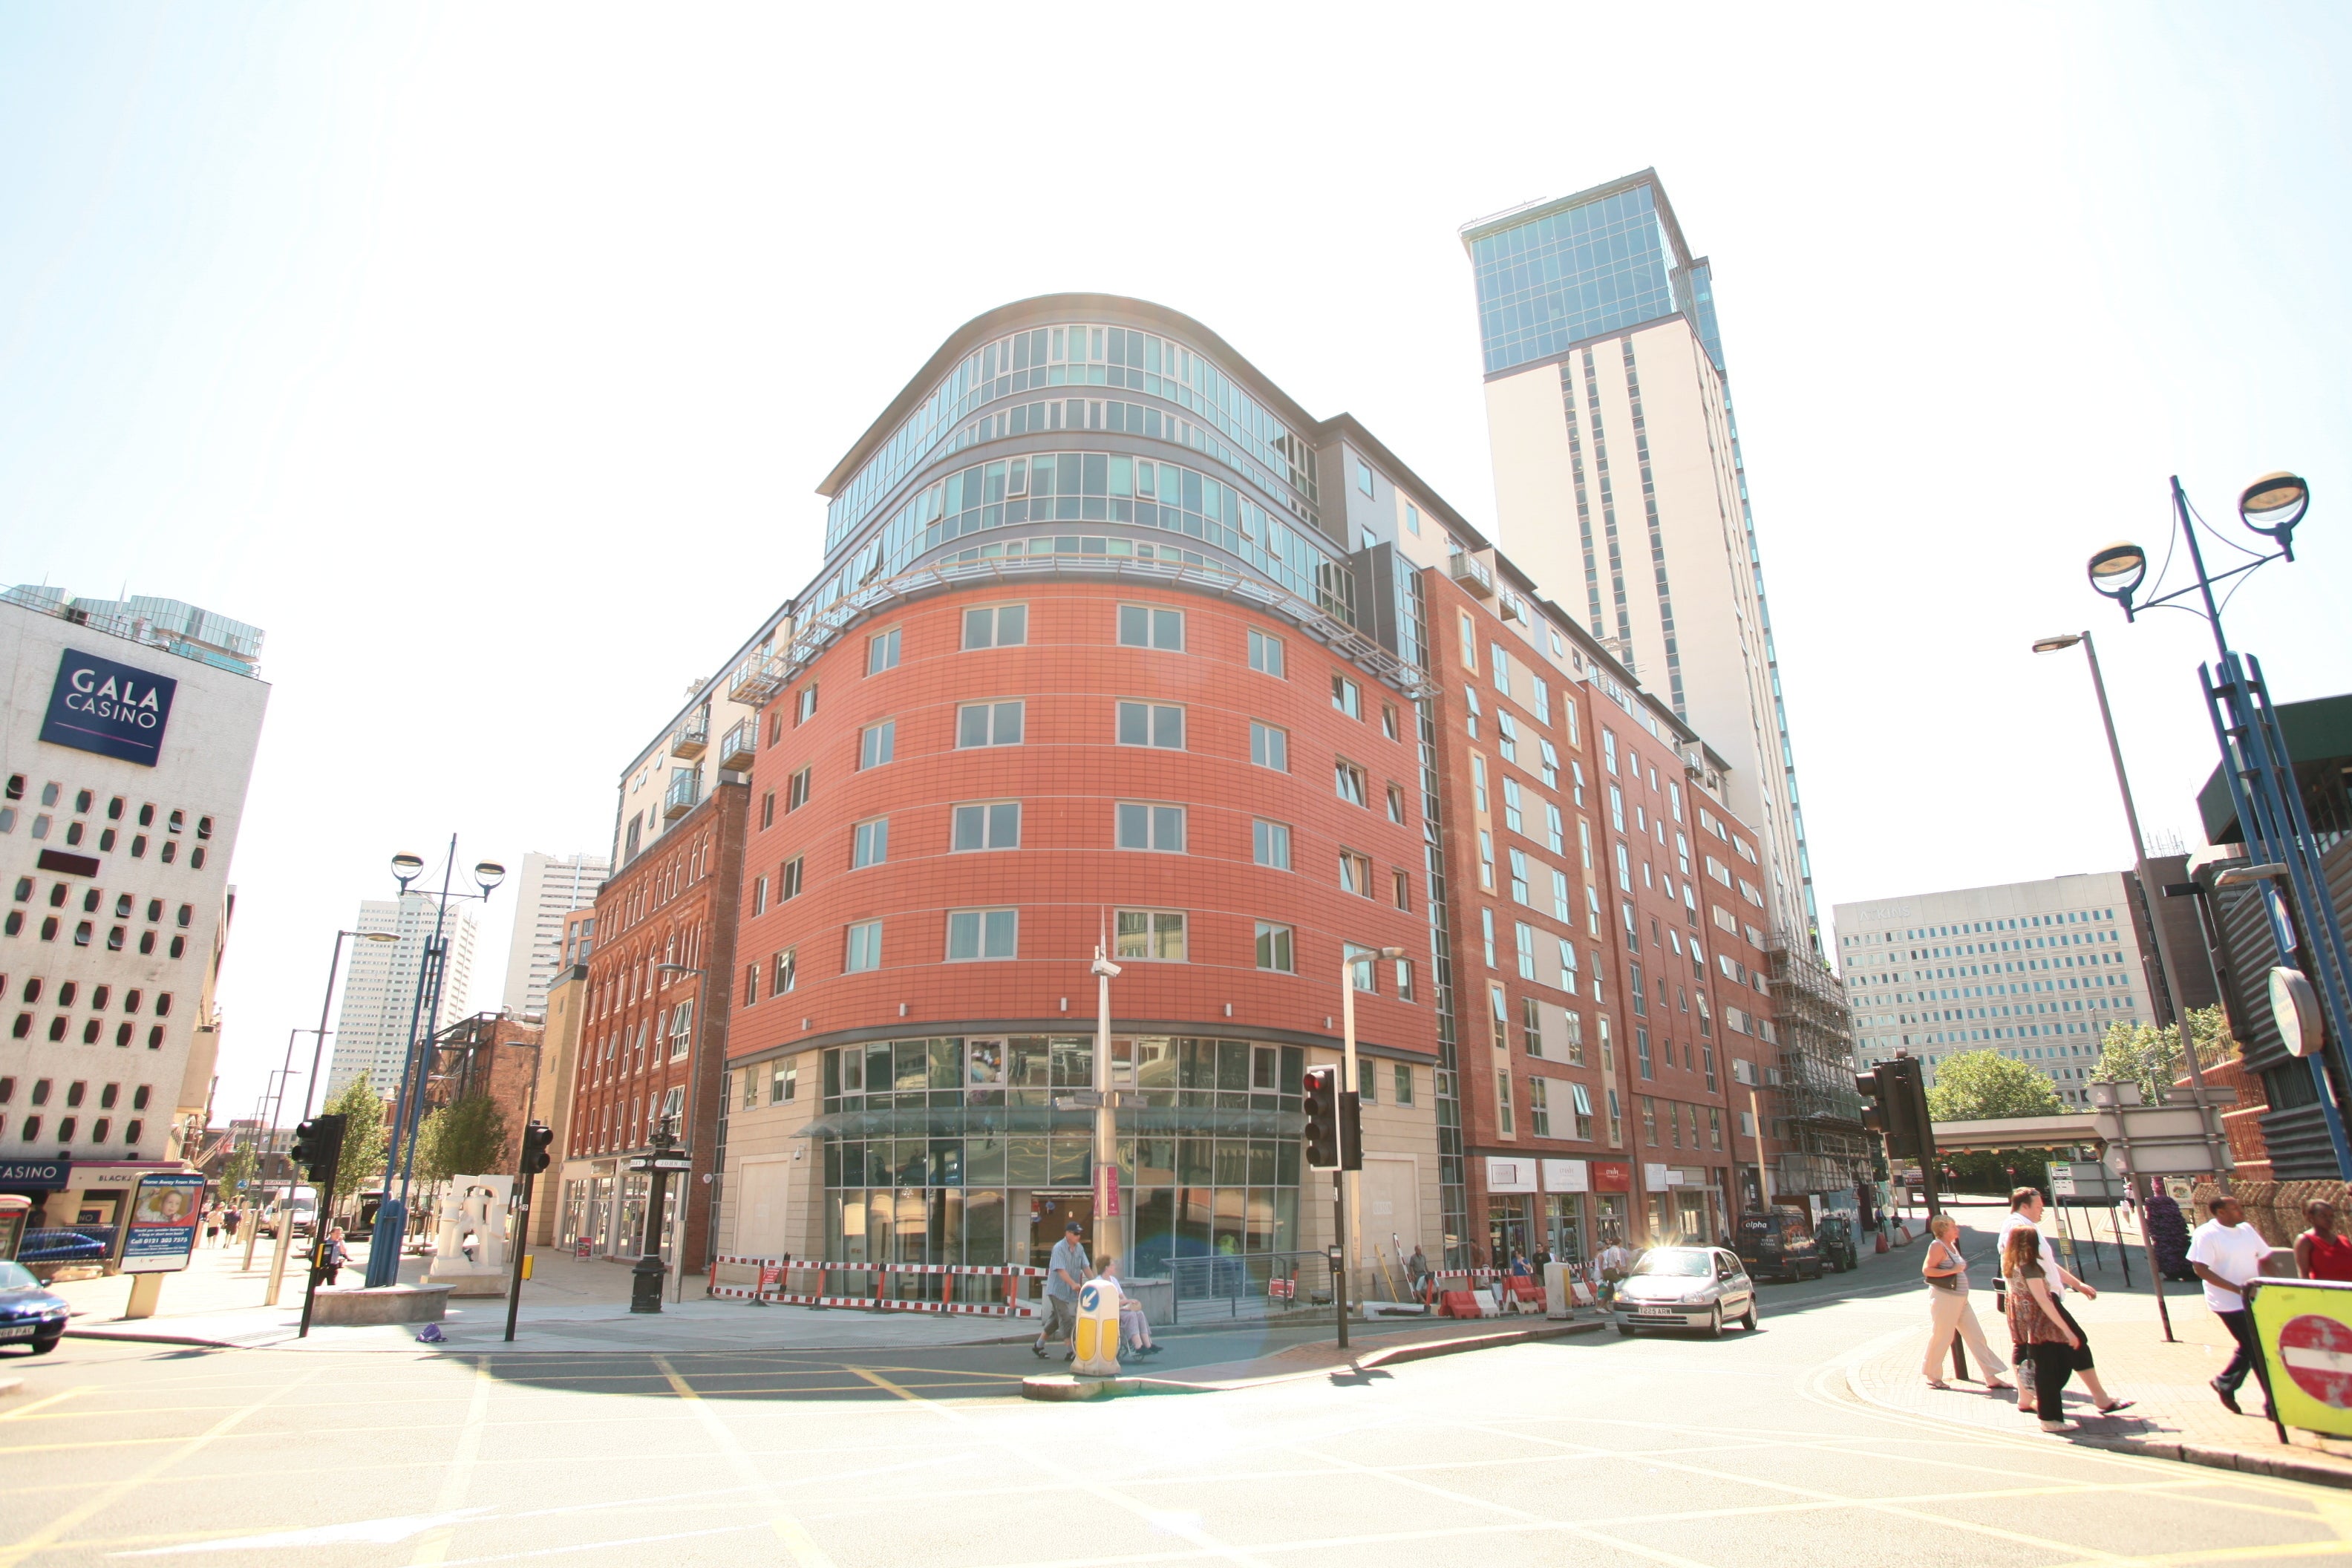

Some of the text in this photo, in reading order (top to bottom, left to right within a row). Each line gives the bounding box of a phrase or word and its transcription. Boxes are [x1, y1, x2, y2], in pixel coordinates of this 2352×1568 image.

[71, 669, 159, 712] GALA
[65, 693, 157, 728] CASINO
[1606, 1167, 1618, 1175] crosby
[1745, 1221, 1767, 1229] alpha
